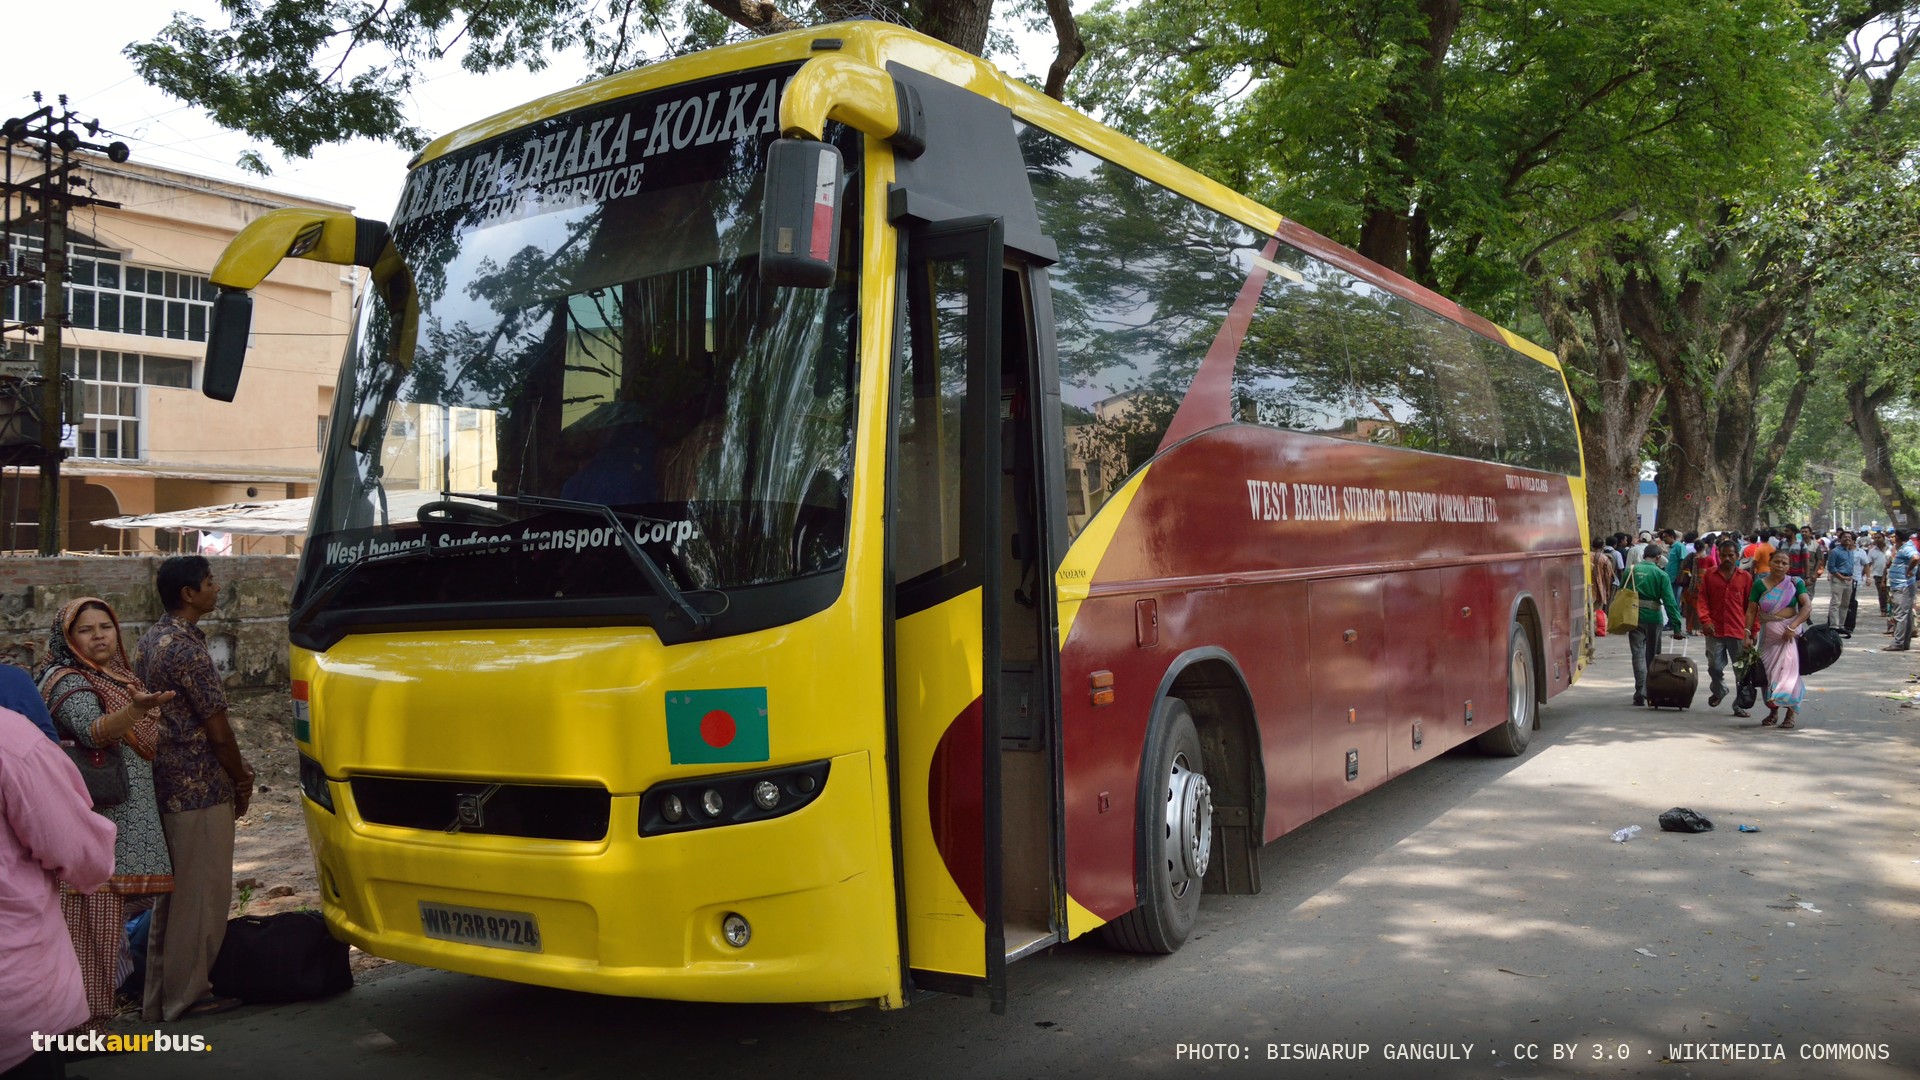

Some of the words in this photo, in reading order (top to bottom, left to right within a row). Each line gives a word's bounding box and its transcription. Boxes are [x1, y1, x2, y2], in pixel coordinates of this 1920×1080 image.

[397, 75, 793, 225] OLKATA-DHAKA-KOLKA
[485, 193, 527, 223] BUS
[541, 163, 644, 206] SERVICE
[1247, 479, 1288, 521] WEST
[1293, 483, 1341, 521] BENGAL
[1343, 486, 1387, 522] SURFACE
[1389, 490, 1437, 522] TRANSPORT
[1439, 494, 1485, 523] CORPORATION
[326, 542, 365, 566] West
[521, 526, 624, 554] transport
[634, 519, 700, 547] Corp.
[1058, 568, 1087, 579] VOLVO
[486, 916, 538, 946] 9224
